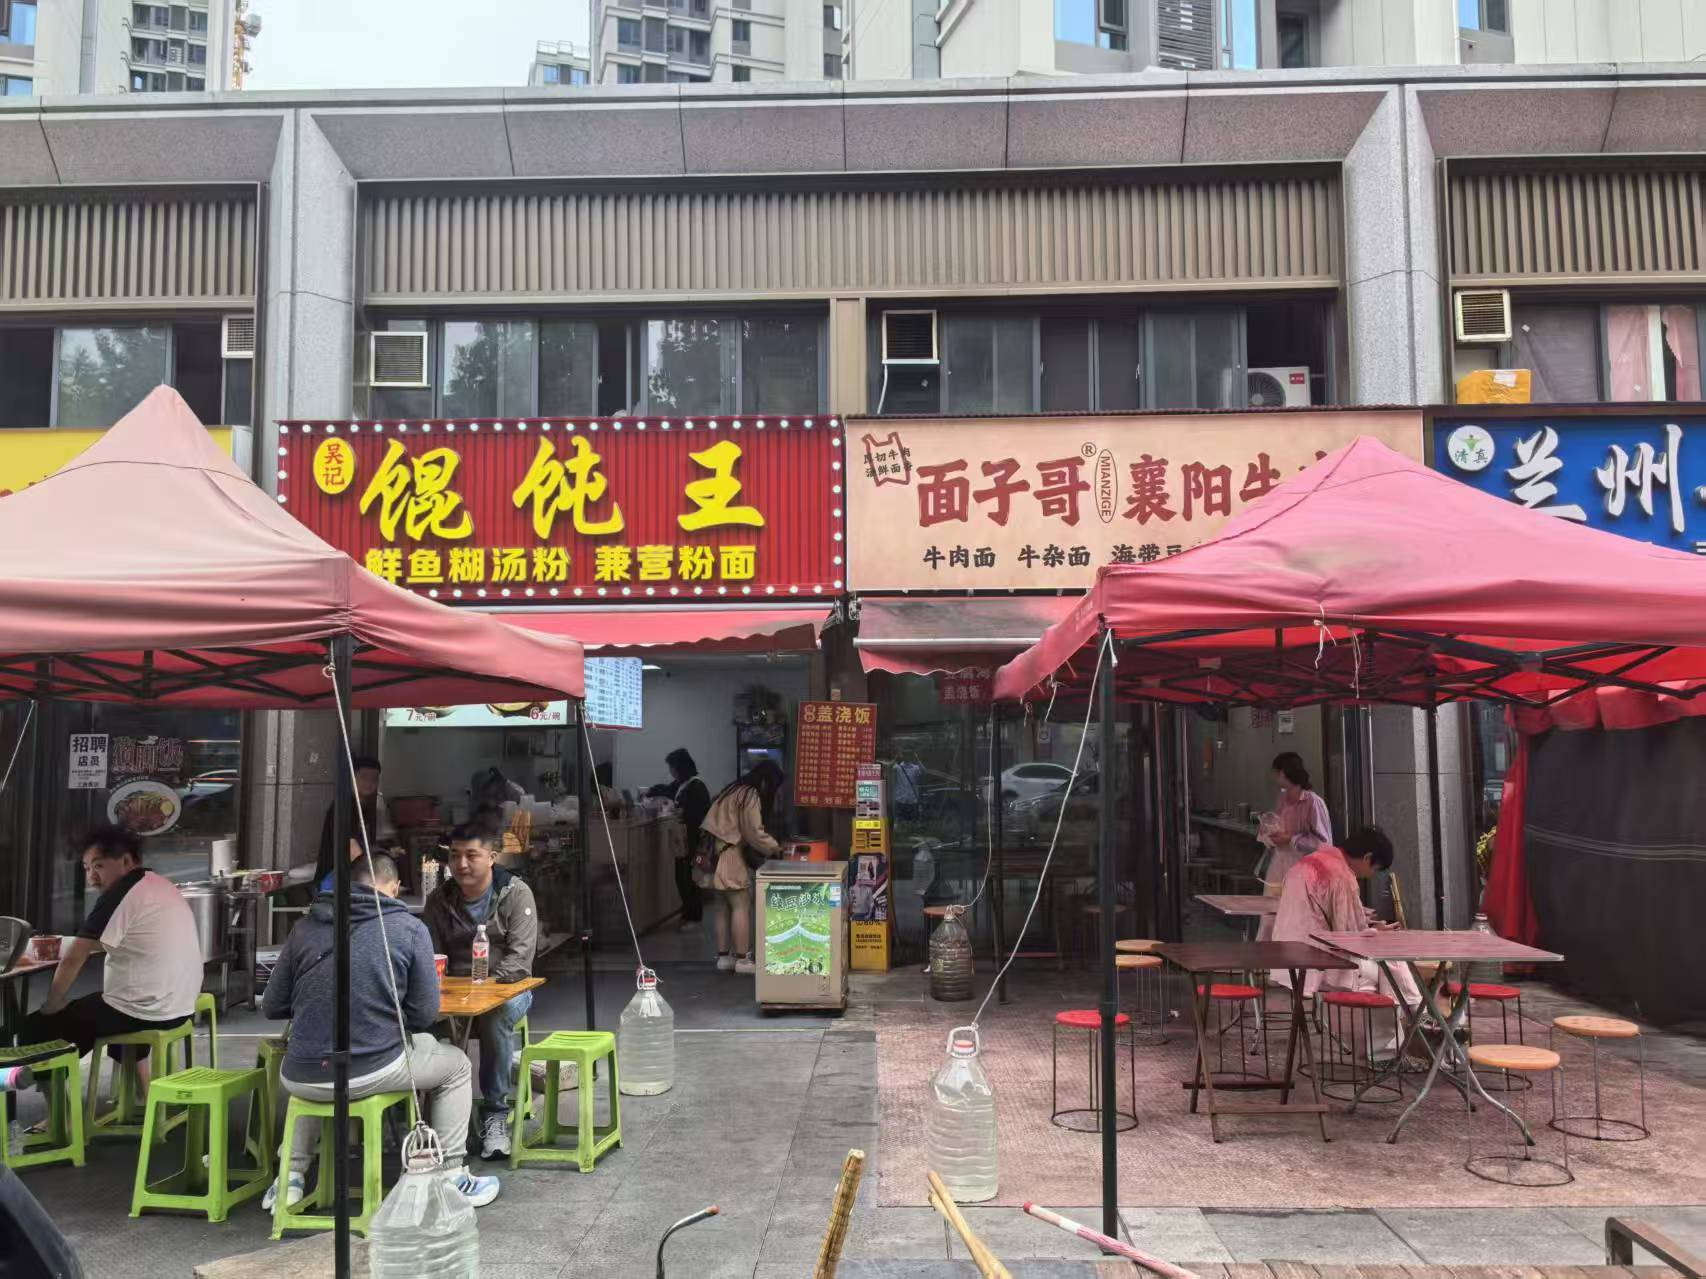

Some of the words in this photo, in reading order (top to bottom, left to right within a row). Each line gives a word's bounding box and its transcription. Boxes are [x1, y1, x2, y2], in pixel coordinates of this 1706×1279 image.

[322, 442, 346, 488] 吴记
[1454, 449, 1488, 464] 清真
[1505, 424, 1706, 534] 兰州
[359, 436, 765, 541] 馄饨王
[916, 455, 1091, 528] 面子哥
[1100, 455, 1113, 518] MIANZIGE
[1122, 450, 1327, 525] 襄阳牛
[364, 545, 570, 584] 鲜鱼糊汤粉
[595, 545, 757, 581] 兼营粉面
[923, 545, 996, 569] 牛肉面
[1017, 545, 1091, 568] 牛杂面
[72, 736, 107, 753] 招聘
